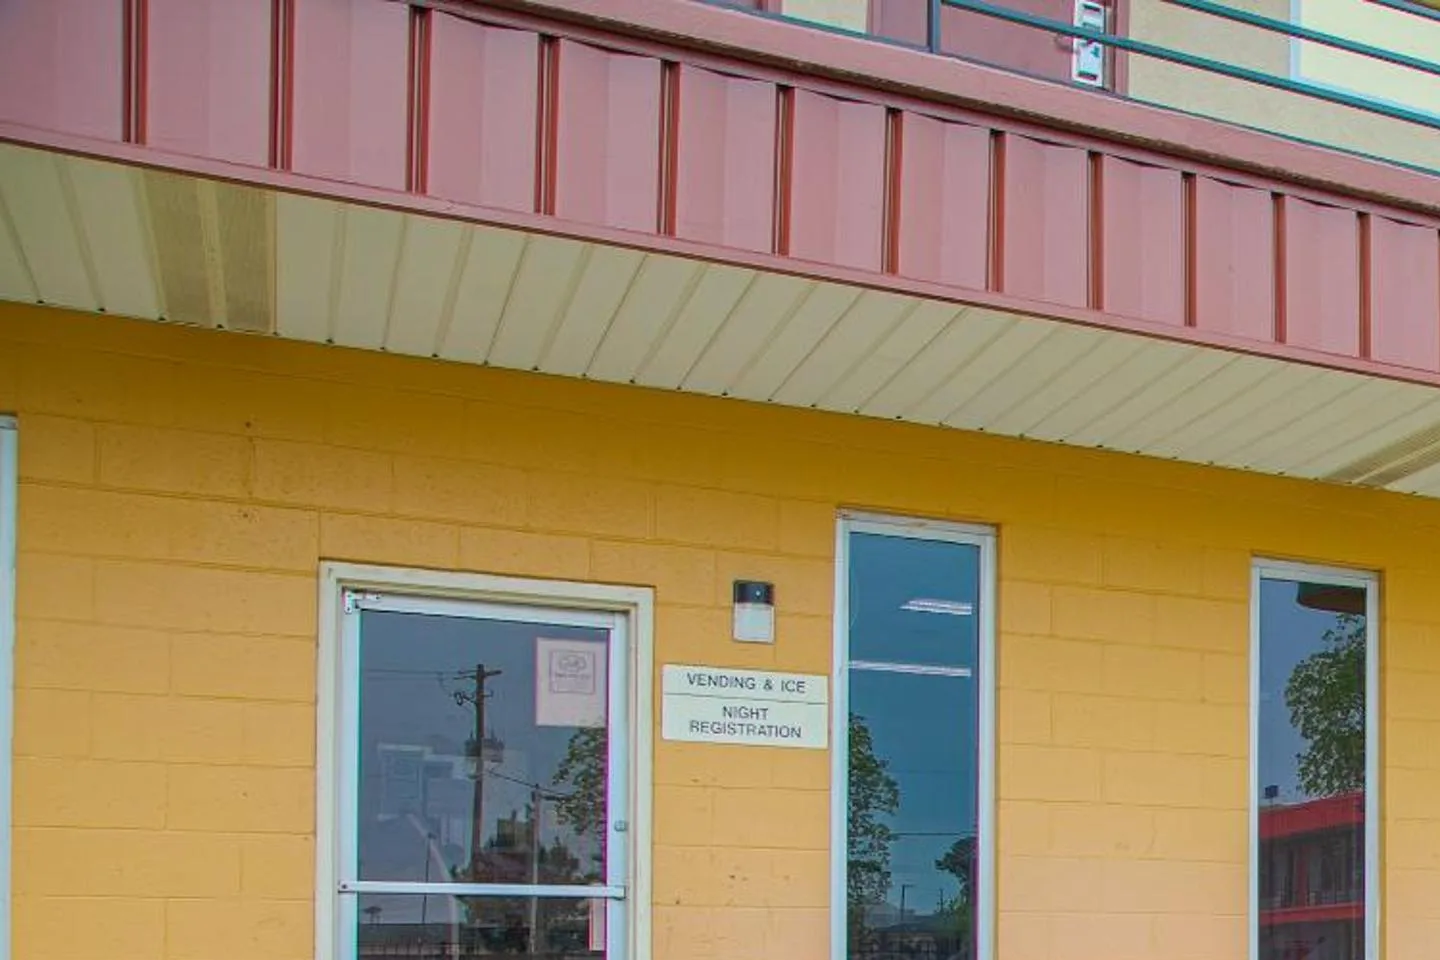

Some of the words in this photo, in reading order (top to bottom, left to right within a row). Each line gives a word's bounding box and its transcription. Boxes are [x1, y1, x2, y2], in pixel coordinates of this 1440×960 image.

[686, 672, 756, 690] VENDING
[763, 678, 773, 691] &
[781, 680, 806, 693] ICE
[722, 706, 769, 720] NIGHT
[689, 720, 802, 738] REGISTRATION
